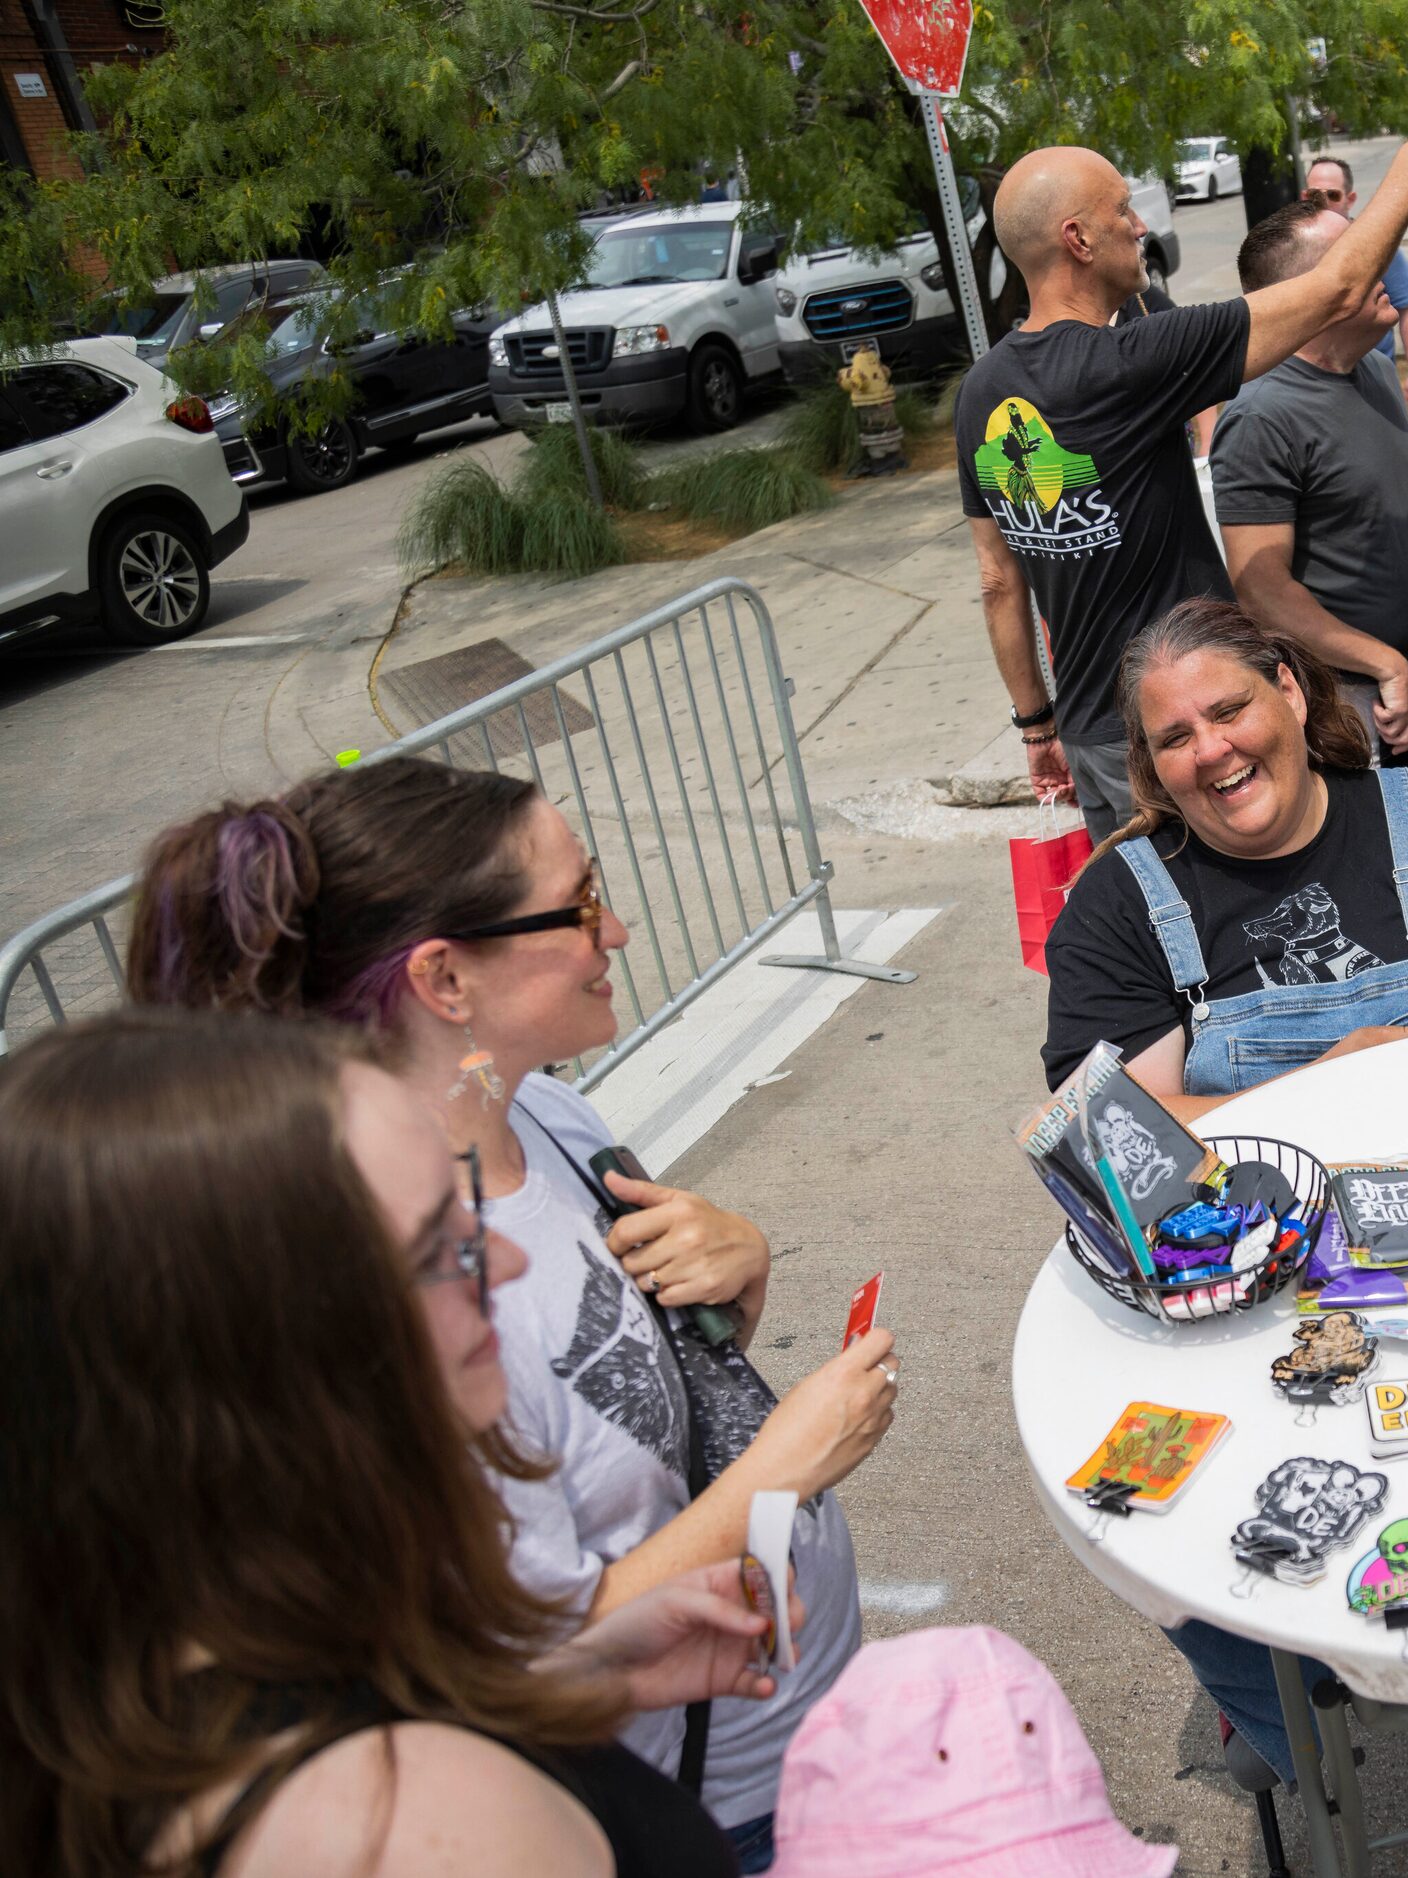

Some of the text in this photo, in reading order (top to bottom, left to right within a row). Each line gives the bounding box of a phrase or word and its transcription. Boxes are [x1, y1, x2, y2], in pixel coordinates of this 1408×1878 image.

[984, 489, 1112, 534] HULA'S
[1038, 538, 1056, 549] LEI
[1065, 526, 1119, 549] STAND
